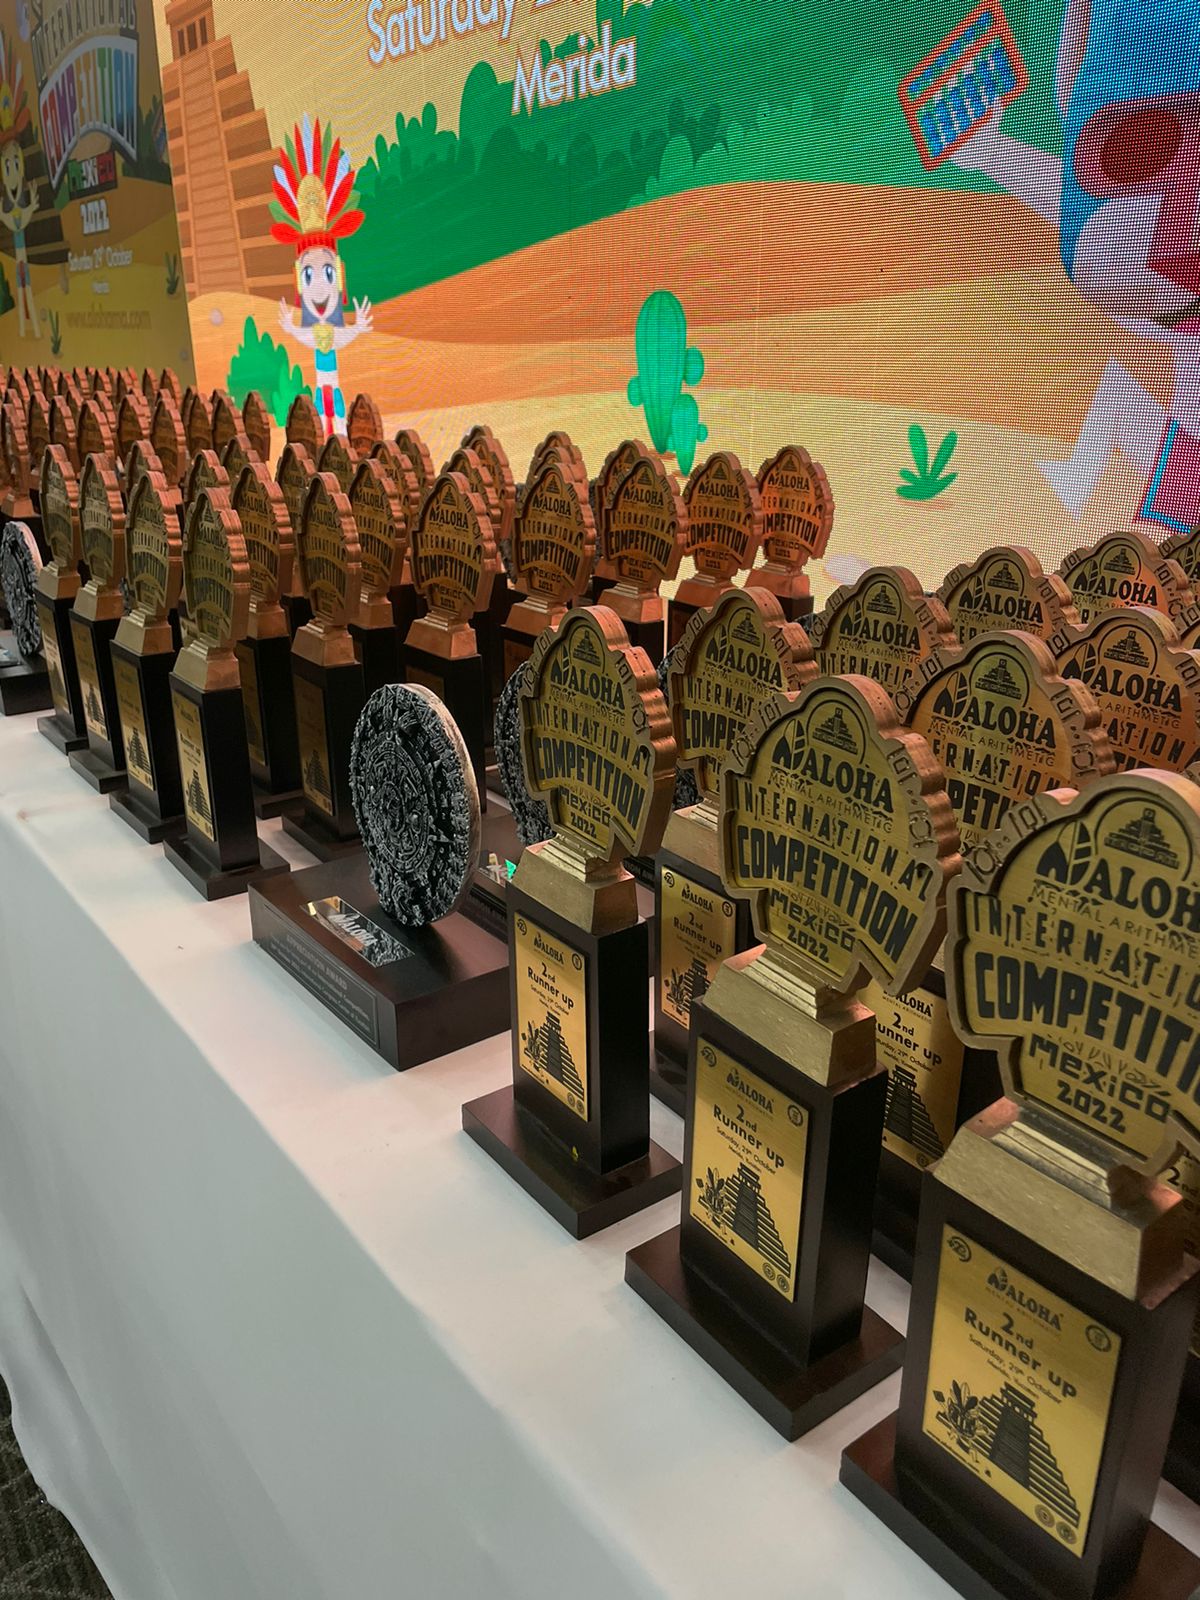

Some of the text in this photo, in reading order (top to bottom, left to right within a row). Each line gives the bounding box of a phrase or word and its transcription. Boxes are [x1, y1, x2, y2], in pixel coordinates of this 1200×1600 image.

[368, 0, 515, 64] Saturday
[512, 22, 636, 113] Merida
[80, 199, 110, 235] 2022
[633, 488, 663, 506] ALOHA
[709, 483, 739, 498] ALOHA
[778, 475, 809, 490] ALOHA
[440, 510, 468, 529] ALOHA
[543, 498, 571, 516] ALOHA
[612, 511, 677, 538] NTERNATIONAL
[762, 496, 823, 519] TERNATIONAL
[420, 534, 482, 564] NTERNATIONAL
[522, 520, 583, 551] NTERNATIONAL
[609, 529, 672, 567] COMPETITION
[419, 555, 480, 597] COMPETITION
[520, 540, 580, 581] COMPETITION
[980, 592, 1043, 623] ALOHA
[1094, 575, 1158, 606] ALOHA
[859, 617, 920, 650] ALOHA
[724, 644, 783, 688] ALOHA
[569, 665, 625, 710] ALOHA
[1090, 665, 1182, 713] ALOHA
[536, 700, 650, 777] NTERNATIONAL
[930, 720, 974, 742] MENTAL
[963, 696, 1056, 749] ALOHA
[536, 736, 646, 831] COMPETITION
[769, 769, 813, 800] MENTAL
[802, 748, 894, 814] ALOHA
[570, 811, 597, 840] 2022
[735, 778, 933, 901] INTERNATIONAL
[689, 892, 714, 912] ALOHA
[737, 824, 918, 964] COMPETITION
[1083, 857, 1200, 934] ALOH
[673, 916, 707, 943] Runner
[709, 940, 722, 955] up
[1032, 885, 1199, 960] MENTAL ARITHME
[541, 942, 564, 965] ALOHA
[786, 923, 830, 964] 2022
[973, 892, 1200, 1012] INTERNATIO
[527, 966, 560, 997] Runner
[561, 993, 574, 1010] up
[892, 1011, 914, 1036] 2nd
[975, 951, 1200, 1100] COMPETITI
[876, 1022, 942, 1066] unner up
[739, 1080, 774, 1114] ALOHA
[1056, 1080, 1127, 1133] 2022
[713, 1103, 762, 1150] Runner
[766, 1147, 785, 1169] up
[736, 1103, 757, 1133] 2nd
[1006, 1284, 1062, 1331] ALOHA
[1002, 1312, 1034, 1349] 2nd
[964, 1306, 1041, 1371] Runner
[1048, 1370, 1077, 1398] up
[1027, 1375, 1063, 1404] October
